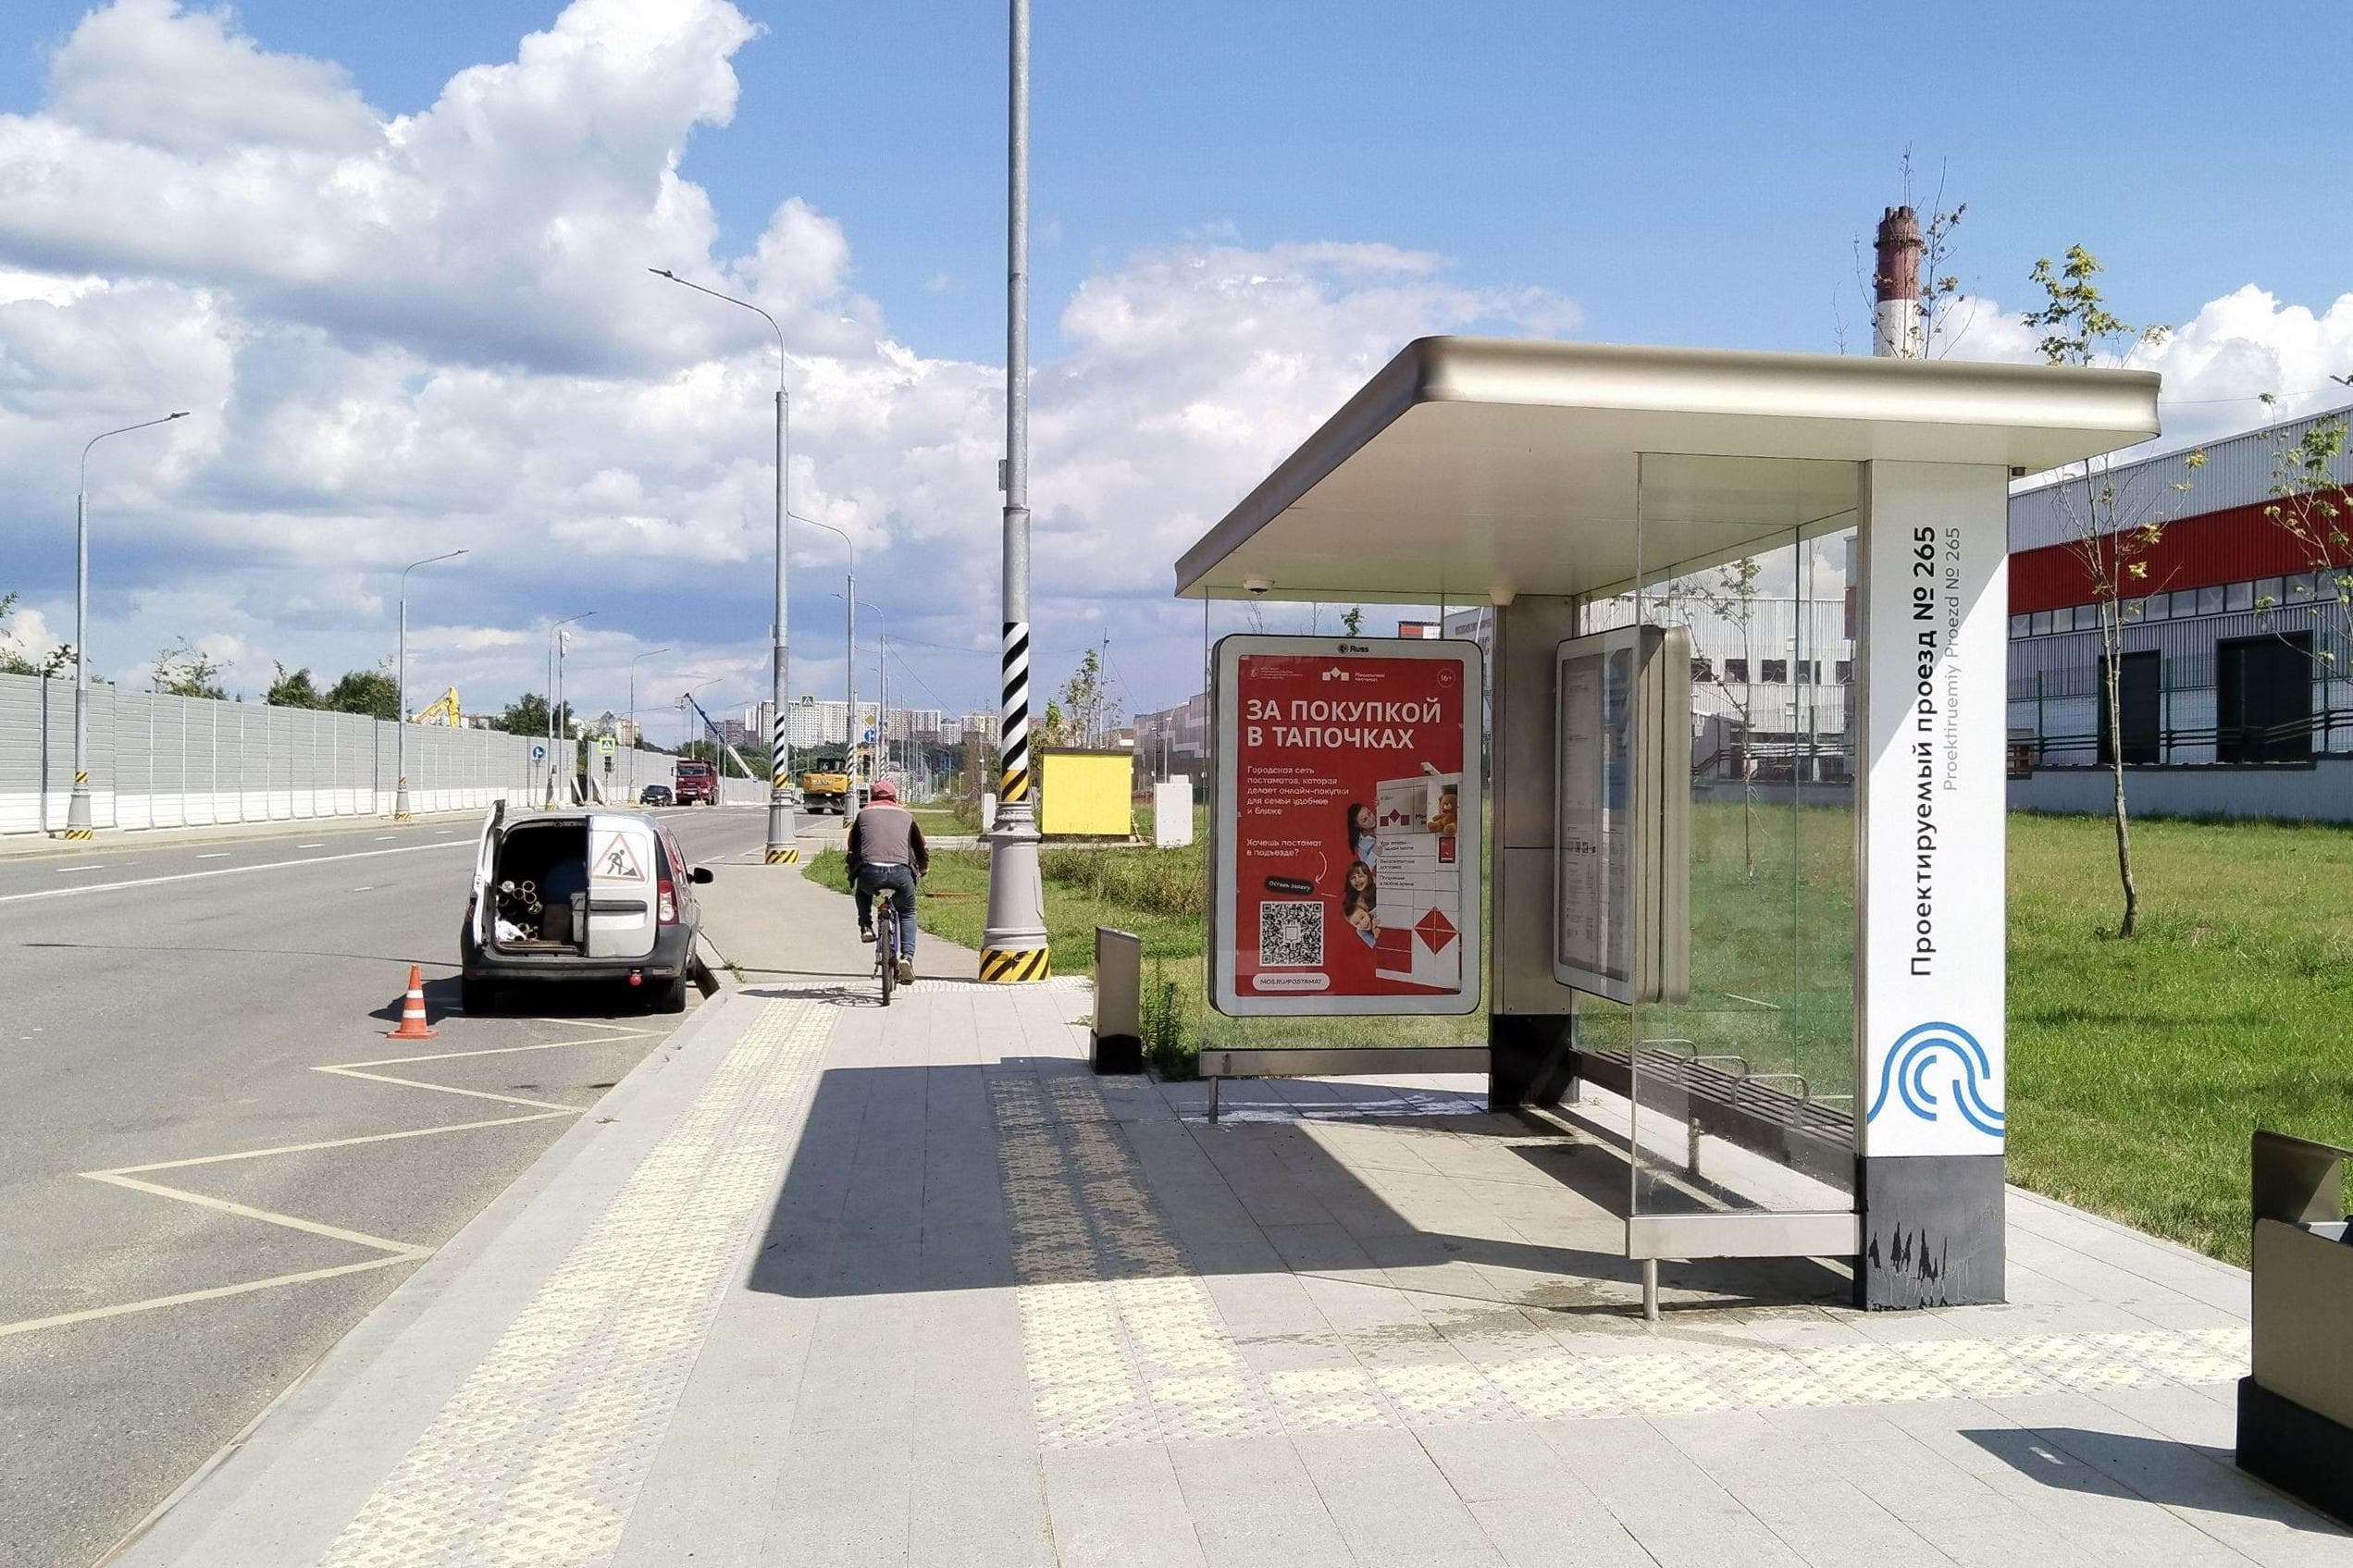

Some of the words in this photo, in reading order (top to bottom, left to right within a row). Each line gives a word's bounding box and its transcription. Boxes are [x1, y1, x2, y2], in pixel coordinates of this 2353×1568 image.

[1913, 526, 1936, 578] 265
[1945, 527, 1961, 562] 265
[1945, 567, 1960, 590] №
[1913, 587, 1934, 621] №
[1945, 596, 1960, 658] Proezd
[1917, 630, 1938, 732] проезд
[1246, 699, 1282, 722] ЗА
[1291, 697, 1442, 723] ПОКУПКОЙ
[1247, 726, 1263, 747] В
[1272, 726, 1415, 749] ТАПОЧКАХ
[1943, 664, 1962, 790] Proektiruemiy
[1247, 766, 1294, 775] Городская
[1247, 777, 1301, 785] постаматов,
[1302, 778, 1338, 786] которая
[1279, 786, 1349, 796] онлайн-покупки
[1294, 797, 1329, 806] удобнее
[1255, 807, 1282, 815] ближе
[1246, 838, 1280, 847] Хочешь
[1254, 848, 1300, 858] подъезде?
[1912, 742, 1937, 976] Проектируемый
